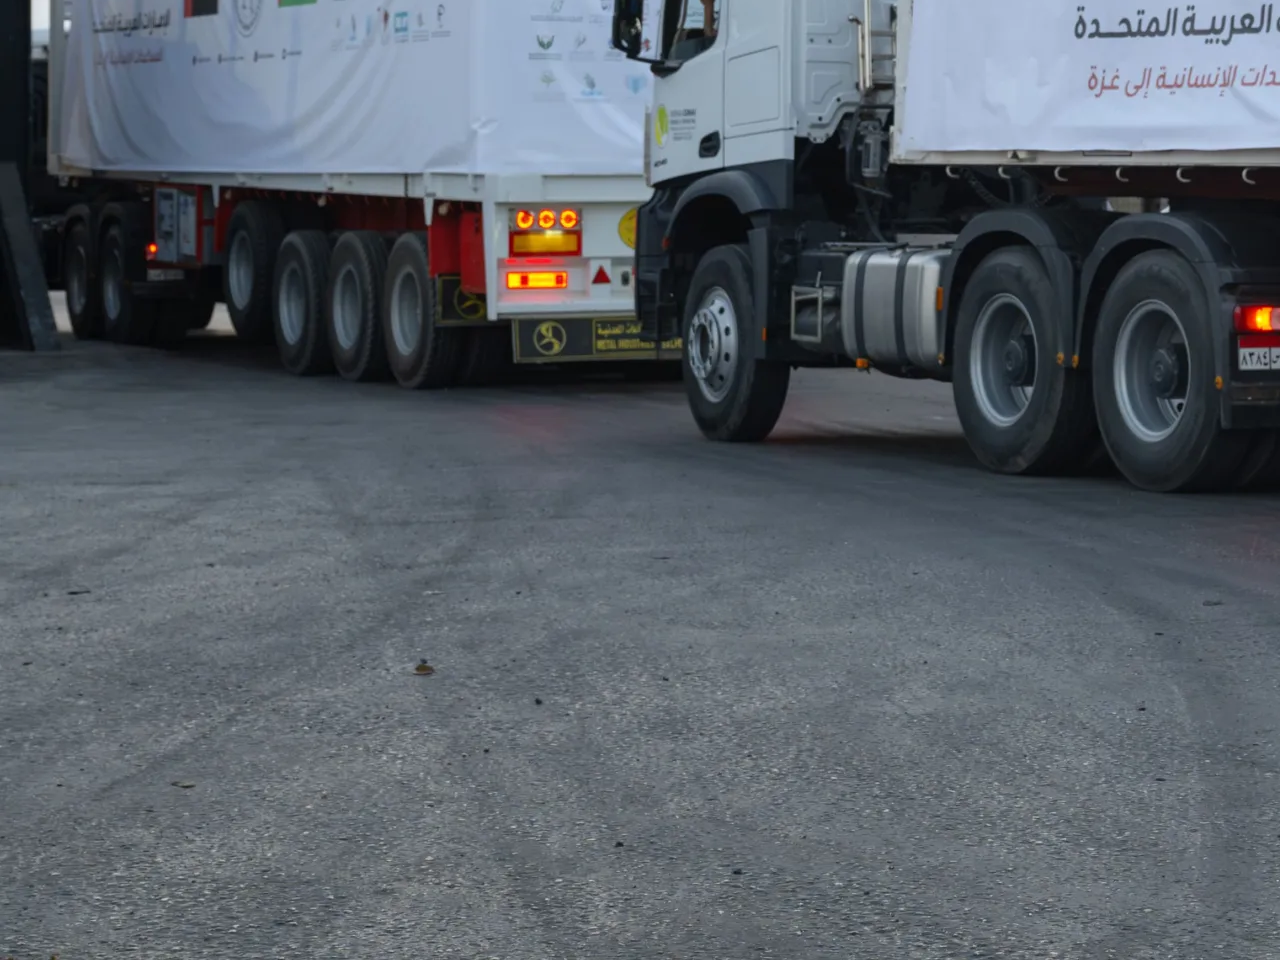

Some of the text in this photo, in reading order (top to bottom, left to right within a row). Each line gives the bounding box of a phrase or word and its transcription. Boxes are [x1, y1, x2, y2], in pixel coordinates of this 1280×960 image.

[1074, 5, 1178, 40] المتحدة
[1182, 4, 1273, 46] العربية
[1087, 64, 1120, 98] غزة
[1125, 67, 1152, 98] إلى
[1155, 64, 1238, 97] الإنسانية
